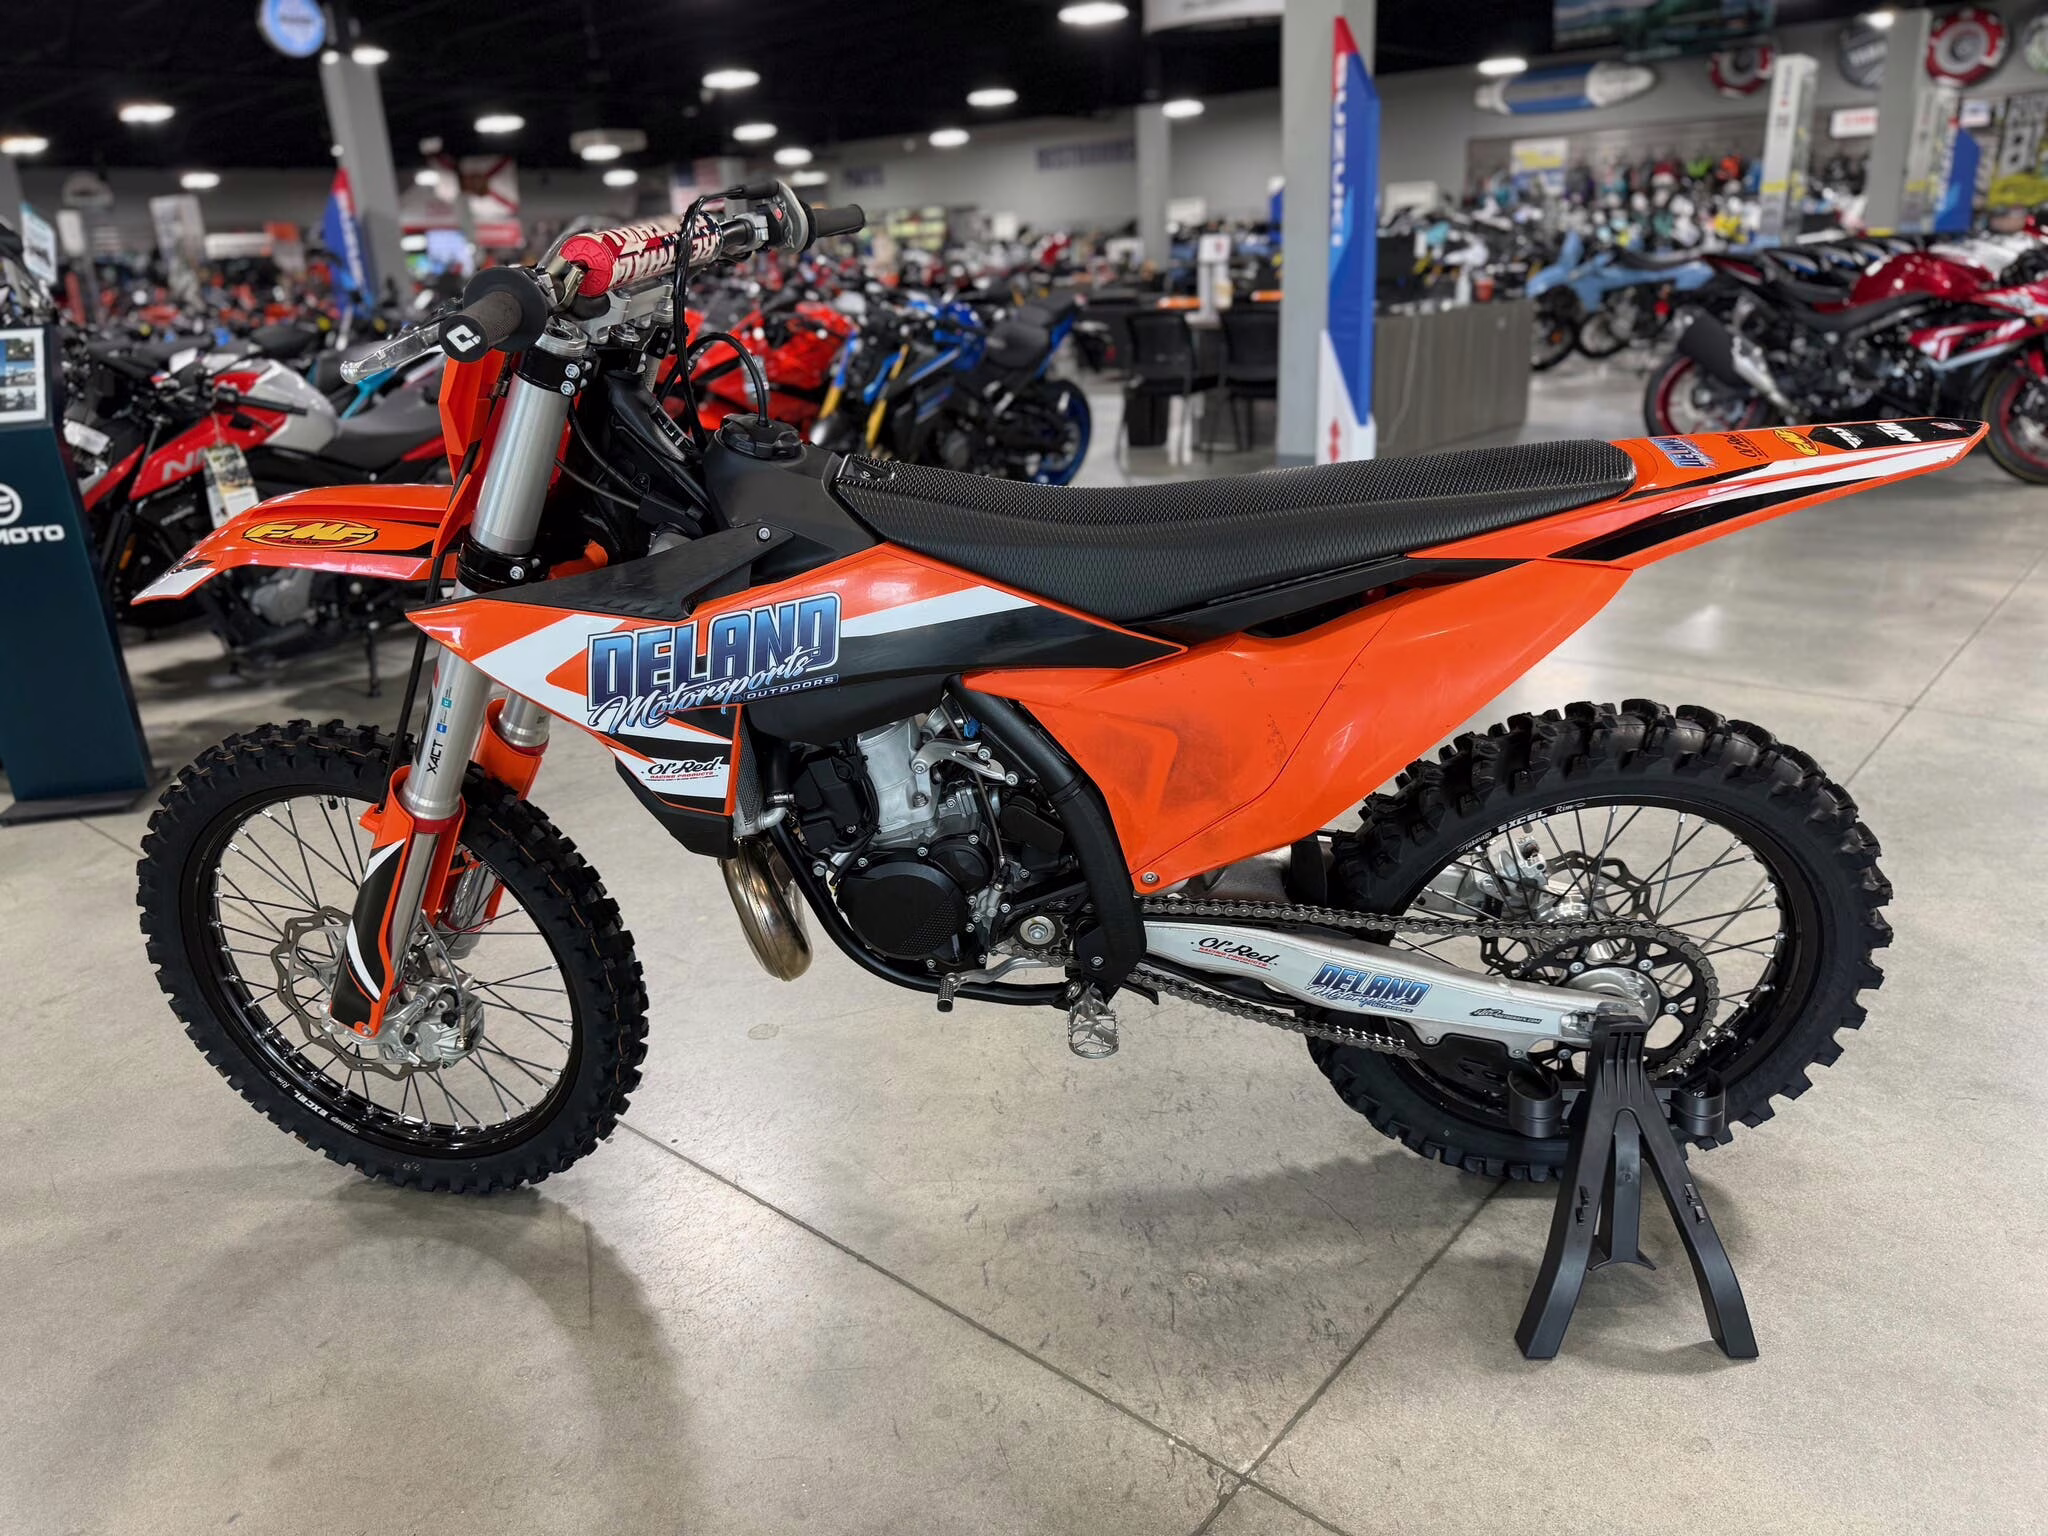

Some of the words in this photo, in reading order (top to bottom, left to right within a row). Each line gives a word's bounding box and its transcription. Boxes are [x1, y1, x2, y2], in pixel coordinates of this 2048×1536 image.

[1876, 423, 1921, 442] KTM
[243, 522, 378, 541] FMF
[588, 593, 841, 712] DELAND
[588, 646, 821, 735] Motorsports
[746, 676, 834, 699] OUTDOORS
[426, 739, 443, 775] XACT
[647, 762, 677, 775] Ol'
[672, 756, 724, 774] Red
[1497, 810, 1548, 833] EXCEL
[1223, 944, 1280, 963] Red
[1308, 962, 1432, 1007] DELAND
[294, 1089, 329, 1117] EXCEL
